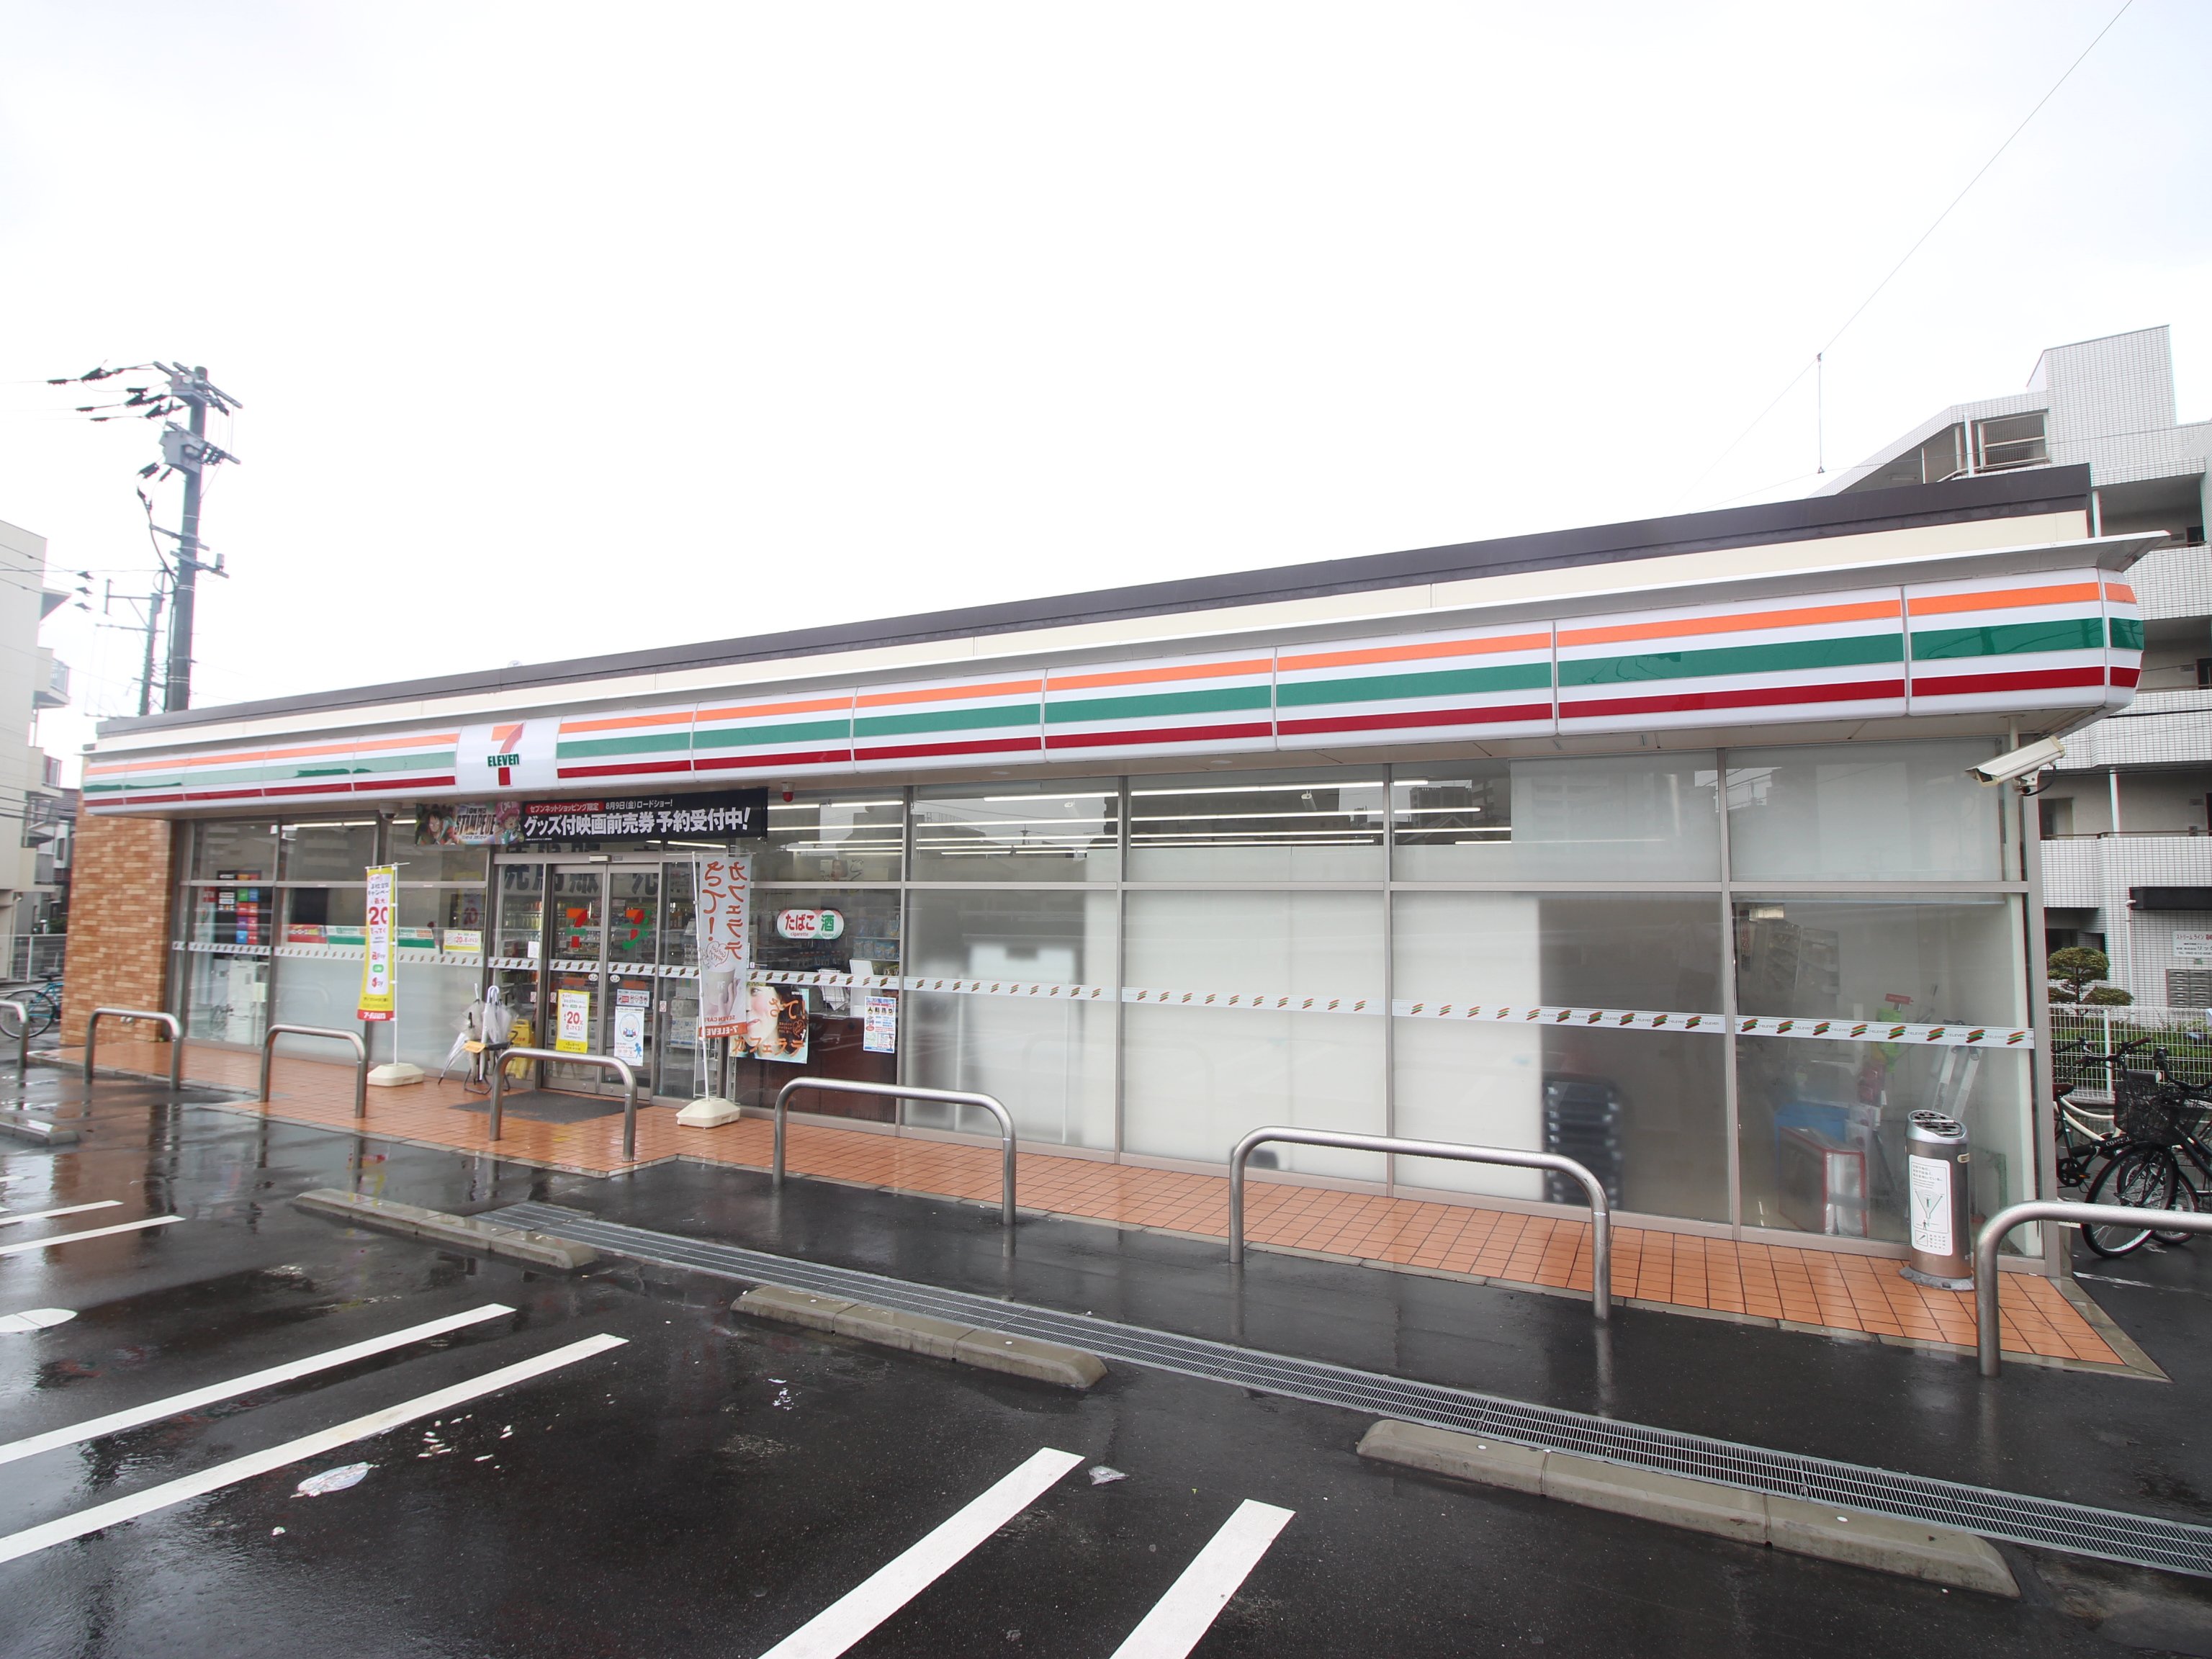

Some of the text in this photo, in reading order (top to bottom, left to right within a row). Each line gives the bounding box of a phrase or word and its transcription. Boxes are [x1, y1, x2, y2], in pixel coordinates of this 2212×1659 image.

[530, 802, 599, 813] セブンネットショッピング限定
[785, 914, 835, 932] たばこ 酒
